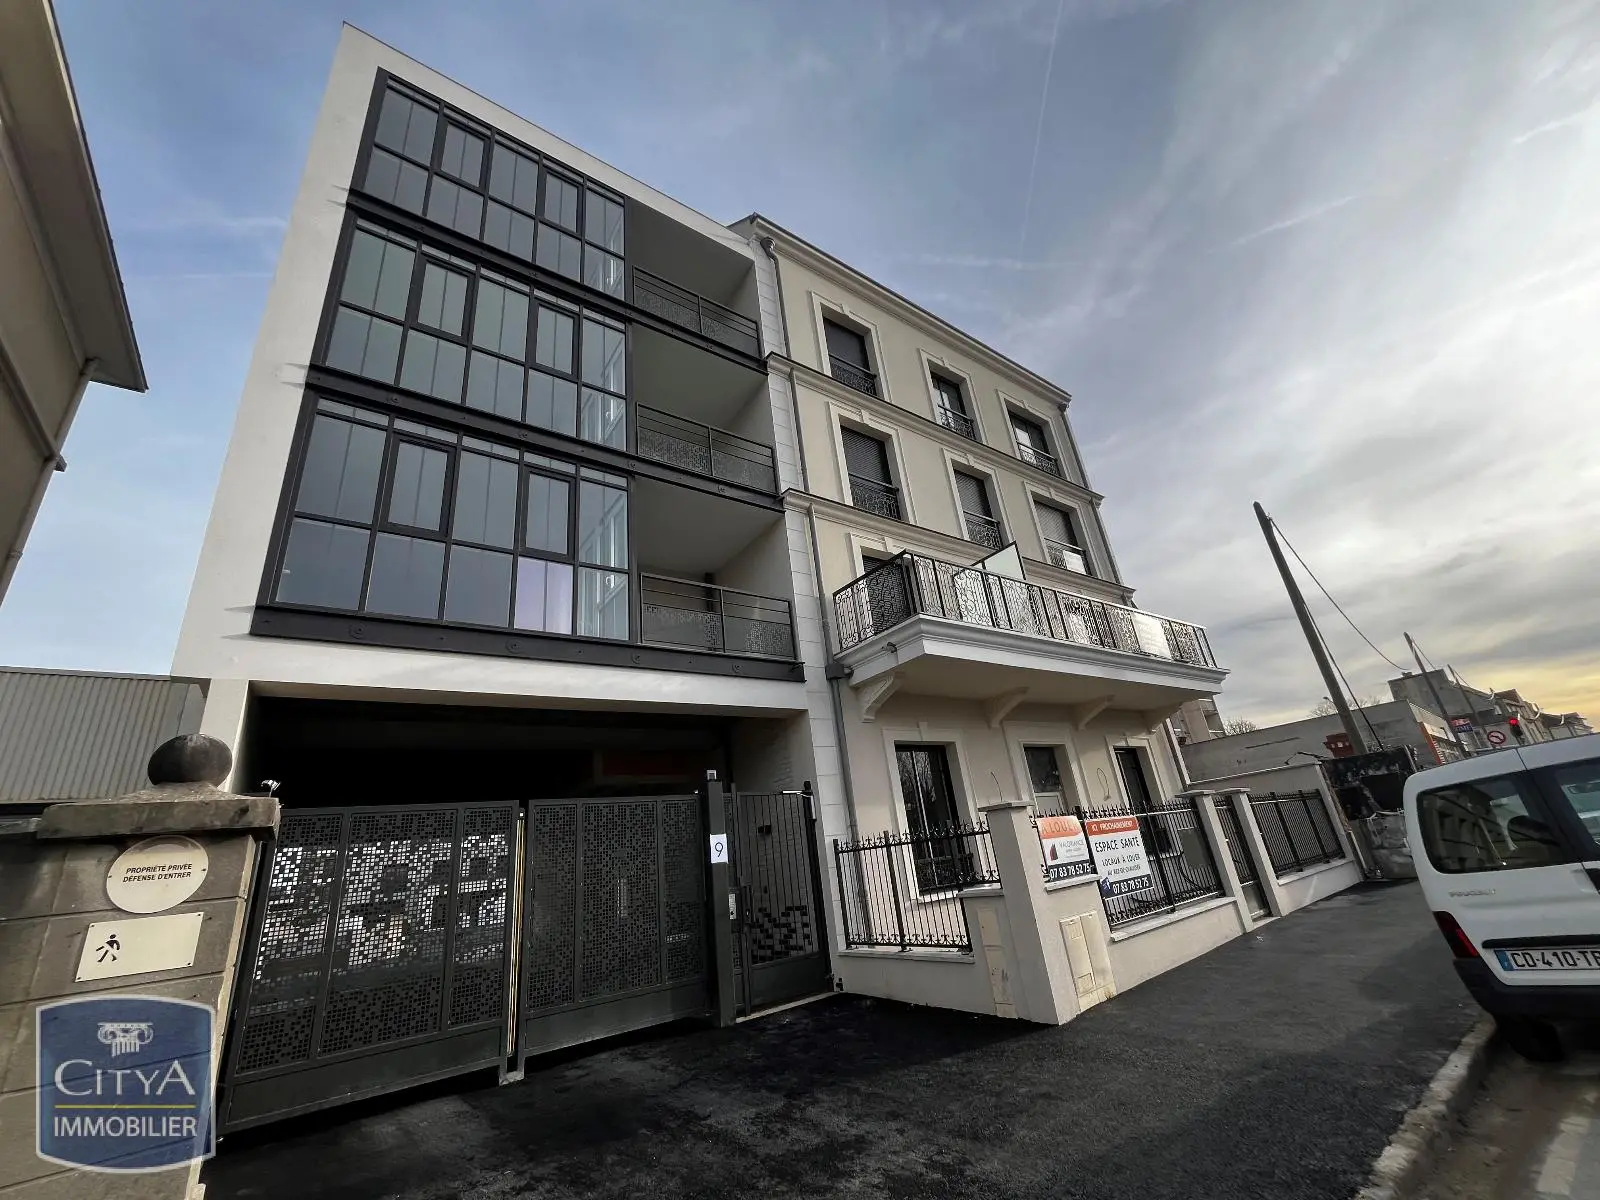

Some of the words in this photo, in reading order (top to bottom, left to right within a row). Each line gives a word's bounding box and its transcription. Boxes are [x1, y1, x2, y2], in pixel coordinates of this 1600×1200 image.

[715, 842, 723, 857] 9
[1095, 839, 1119, 853] ESPACE
[1102, 856, 1120, 867] LOCAUX
[1127, 853, 1140, 864] LOUER
[157, 871, 192, 880] D'ENTRER
[1050, 868, 1058, 879] 07
[1059, 866, 1067, 877] 83
[1067, 865, 1075, 876] 78
[1075, 863, 1083, 874] 52
[1083, 862, 1090, 873] 75
[1113, 883, 1120, 894] 07
[1121, 882, 1128, 893] 83
[1128, 880, 1135, 890] 78
[1135, 878, 1142, 889] 52
[1143, 877, 1149, 887] 75
